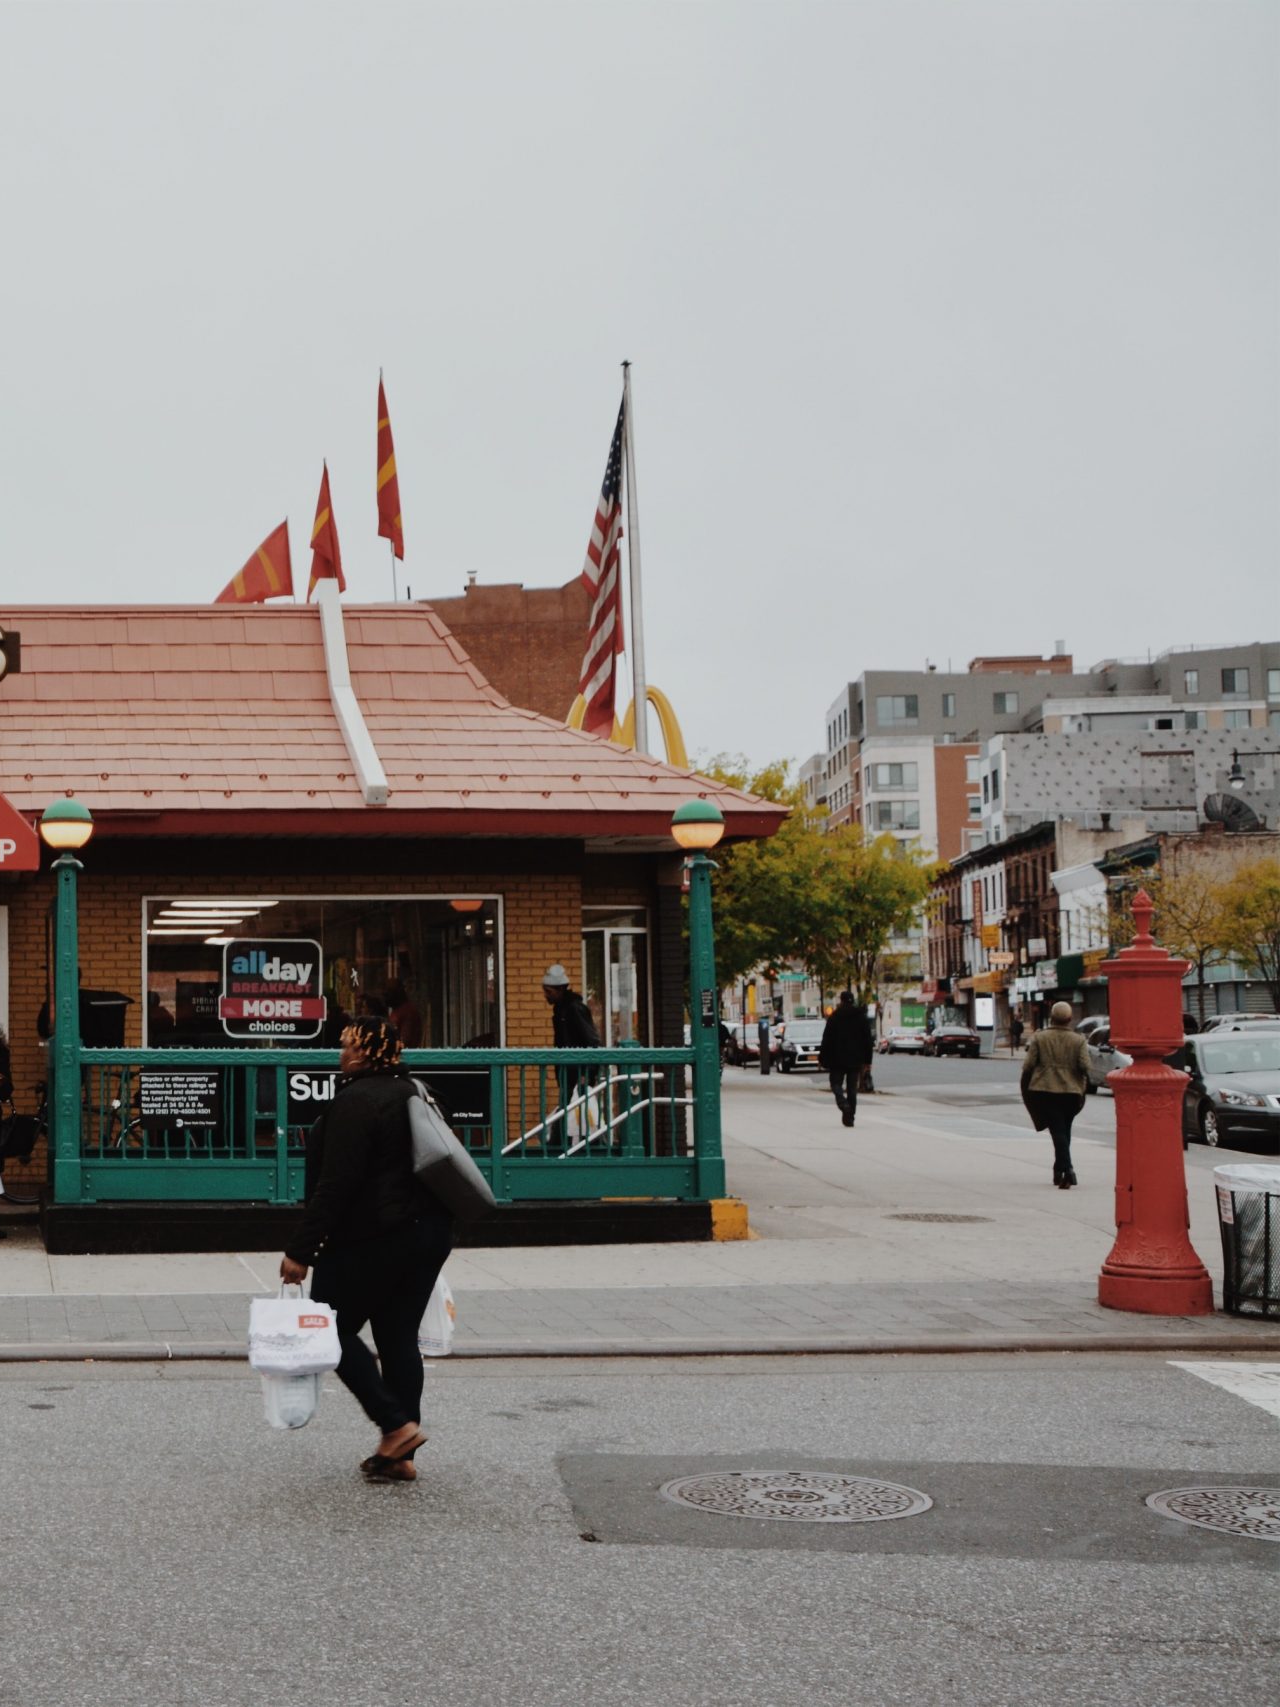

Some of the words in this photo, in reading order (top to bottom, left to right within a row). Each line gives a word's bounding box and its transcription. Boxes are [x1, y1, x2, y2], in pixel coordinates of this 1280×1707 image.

[232, 982, 311, 993] BREAKFAST
[242, 1000, 303, 1017] MORE
[248, 1020, 296, 1032] choices
